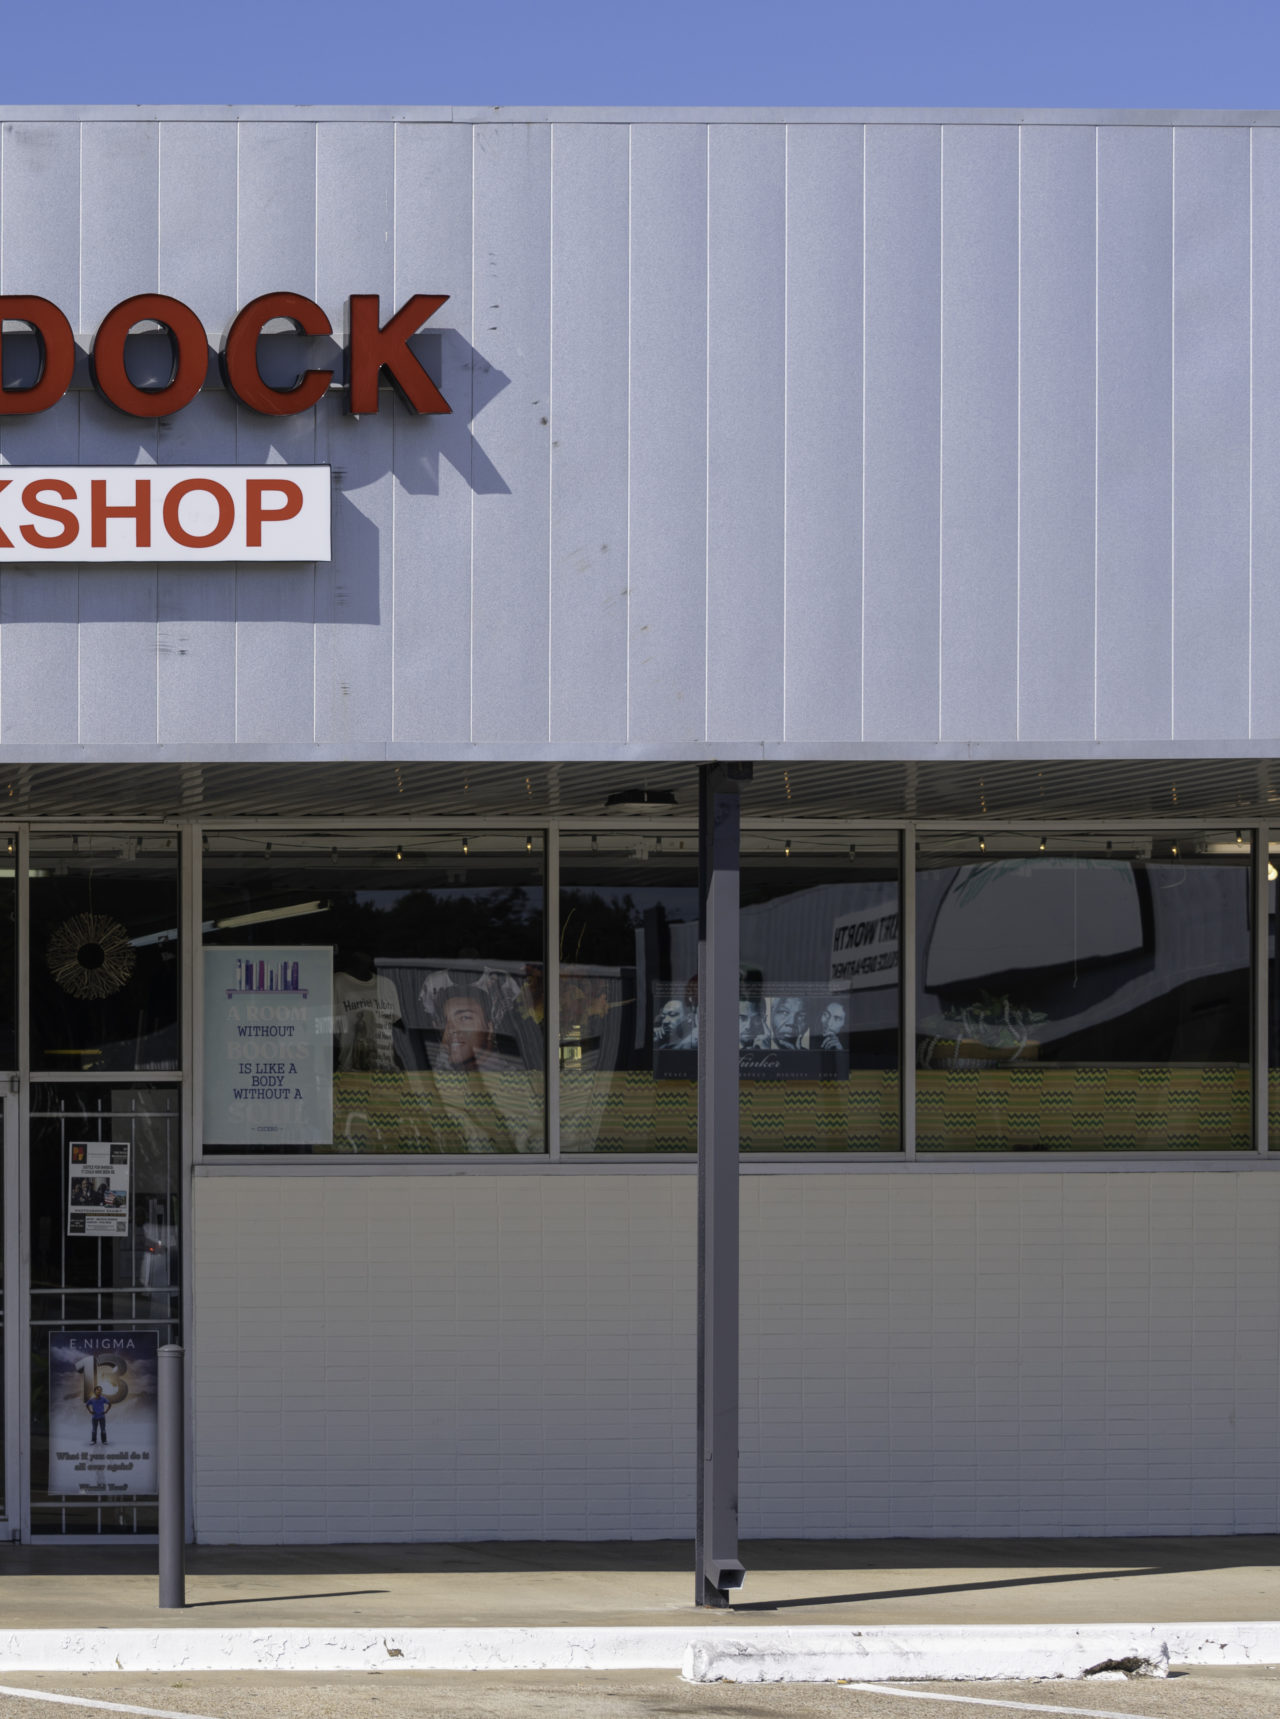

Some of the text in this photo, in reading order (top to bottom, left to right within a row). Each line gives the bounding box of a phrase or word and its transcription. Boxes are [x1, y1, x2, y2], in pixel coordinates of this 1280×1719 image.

[225, 1006, 308, 1021] A ROOM
[237, 1026, 295, 1037] WITHOUT
[225, 1041, 310, 1060] BOOKS
[239, 1063, 298, 1074] IS LIKE A
[251, 1076, 284, 1087] BODY
[233, 1089, 303, 1100] WITHOUT A
[69, 1338, 136, 1349] E.NIGMA
[75, 1353, 129, 1404] 13
[56, 1452, 79, 1460] What
[90, 1453, 105, 1462] you
[106, 1452, 129, 1460] could
[130, 1452, 141, 1460] do
[75, 1463, 86, 1471] all
